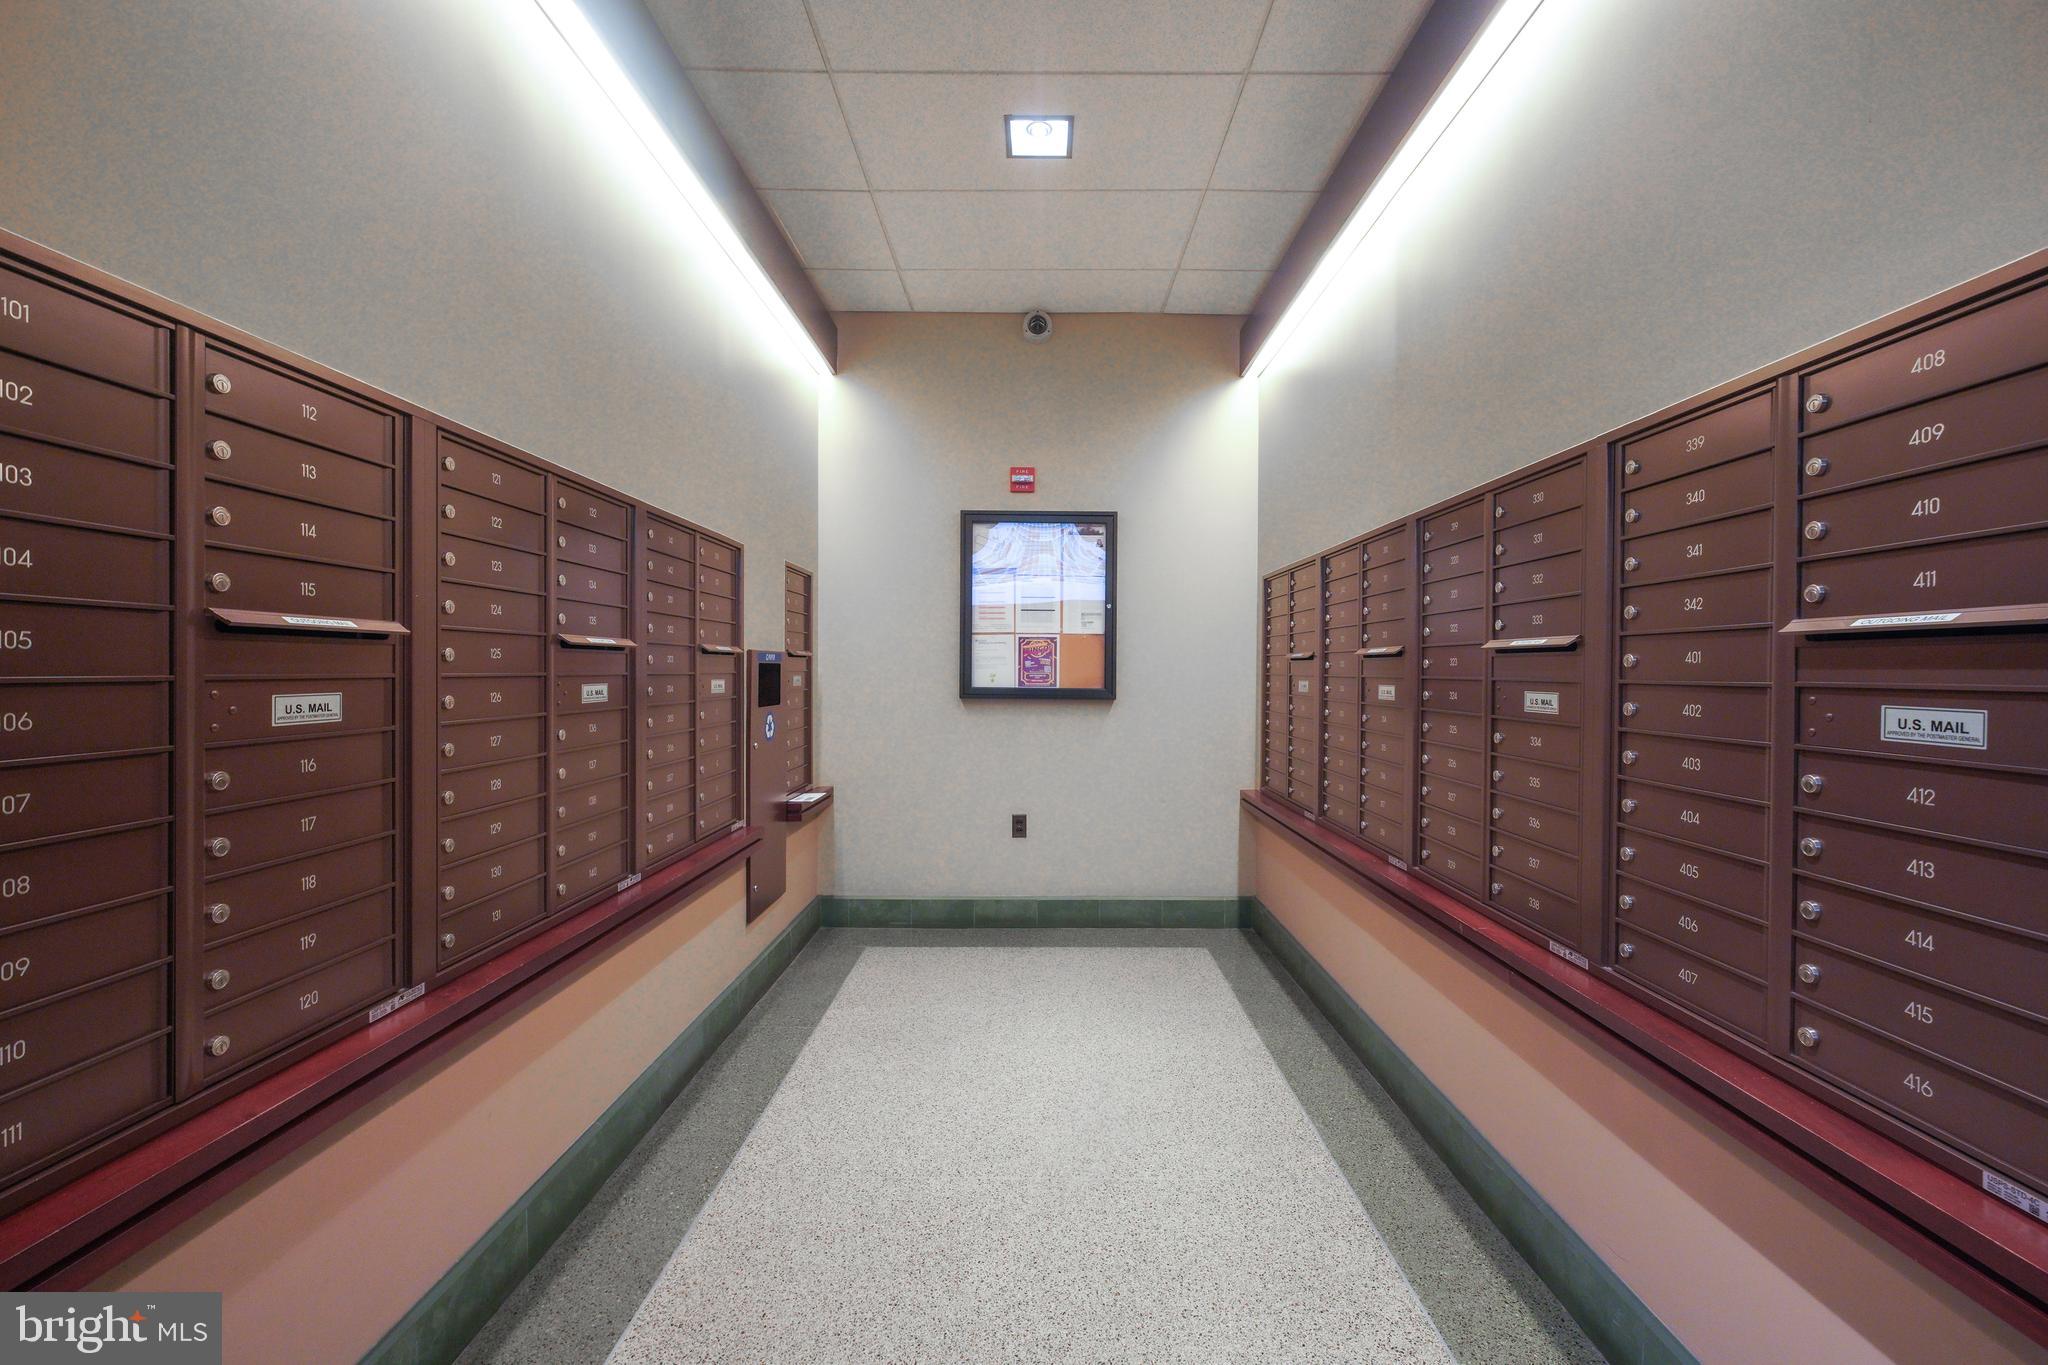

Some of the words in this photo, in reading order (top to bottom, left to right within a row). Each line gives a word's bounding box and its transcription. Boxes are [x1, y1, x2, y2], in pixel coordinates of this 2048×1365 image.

[1, 296, 30, 323] 101
[1911, 350, 1945, 373] 408
[0, 379, 33, 406] 102
[302, 404, 316, 421] 112
[1909, 424, 1944, 445] 409
[1686, 436, 1704, 452] 339
[0, 462, 32, 487] 103
[302, 464, 316, 479] 113
[491, 472, 501, 486] 121
[1532, 491, 1545, 505] 330
[1687, 489, 1705, 504] 340
[1912, 498, 1940, 516] 410
[491, 515, 503, 529] 122
[301, 523, 316, 538] 114
[1533, 532, 1543, 544] 331
[1687, 544, 1702, 557] 341
[491, 560, 503, 572] 123
[1532, 572, 1544, 585] 332
[1913, 571, 1936, 587] 411
[301, 582, 315, 596] 115
[490, 604, 503, 616] 124
[1684, 597, 1703, 610] 342
[1531, 614, 1543, 625] 333
[1861, 615, 1921, 625] OUTGOING
[1921, 613, 1951, 622] MAIL
[490, 647, 502, 659] 125
[1685, 651, 1701, 663] 401
[489, 691, 502, 703] 126
[1540, 699, 1554, 707] MAIL
[285, 704, 305, 715] U.S.
[308, 702, 332, 713] MAIL
[1683, 704, 1701, 717] 402
[1898, 718, 1926, 731] U.S.
[1930, 720, 1969, 734] MAIL
[490, 735, 502, 747] 127
[1529, 735, 1542, 747] 334
[1926, 733, 1958, 741] POSTMASTER
[301, 758, 316, 772] 116
[1682, 757, 1700, 771] 403
[490, 778, 502, 791] 128
[1528, 776, 1541, 788] 335
[1907, 787, 1935, 806] 412
[301, 816, 316, 832] 117
[1528, 816, 1541, 829] 336
[1681, 810, 1699, 824] 404
[490, 821, 502, 835] 129
[1528, 856, 1540, 870] 337
[1907, 859, 1934, 878] 413
[490, 864, 502, 879] 130
[1680, 863, 1698, 878] 405
[302, 875, 316, 891] 118
[1528, 896, 1540, 911] 338
[492, 908, 502, 922] 131
[1679, 916, 1698, 932] 406
[301, 933, 316, 950] 119
[1905, 930, 1934, 951] 414
[1679, 969, 1698, 984] 407
[300, 991, 318, 1010] 120
[1904, 1002, 1933, 1024] 415
[0, 1039, 26, 1067] 110
[1904, 1073, 1933, 1097] 416
[1, 1121, 23, 1148] 111
